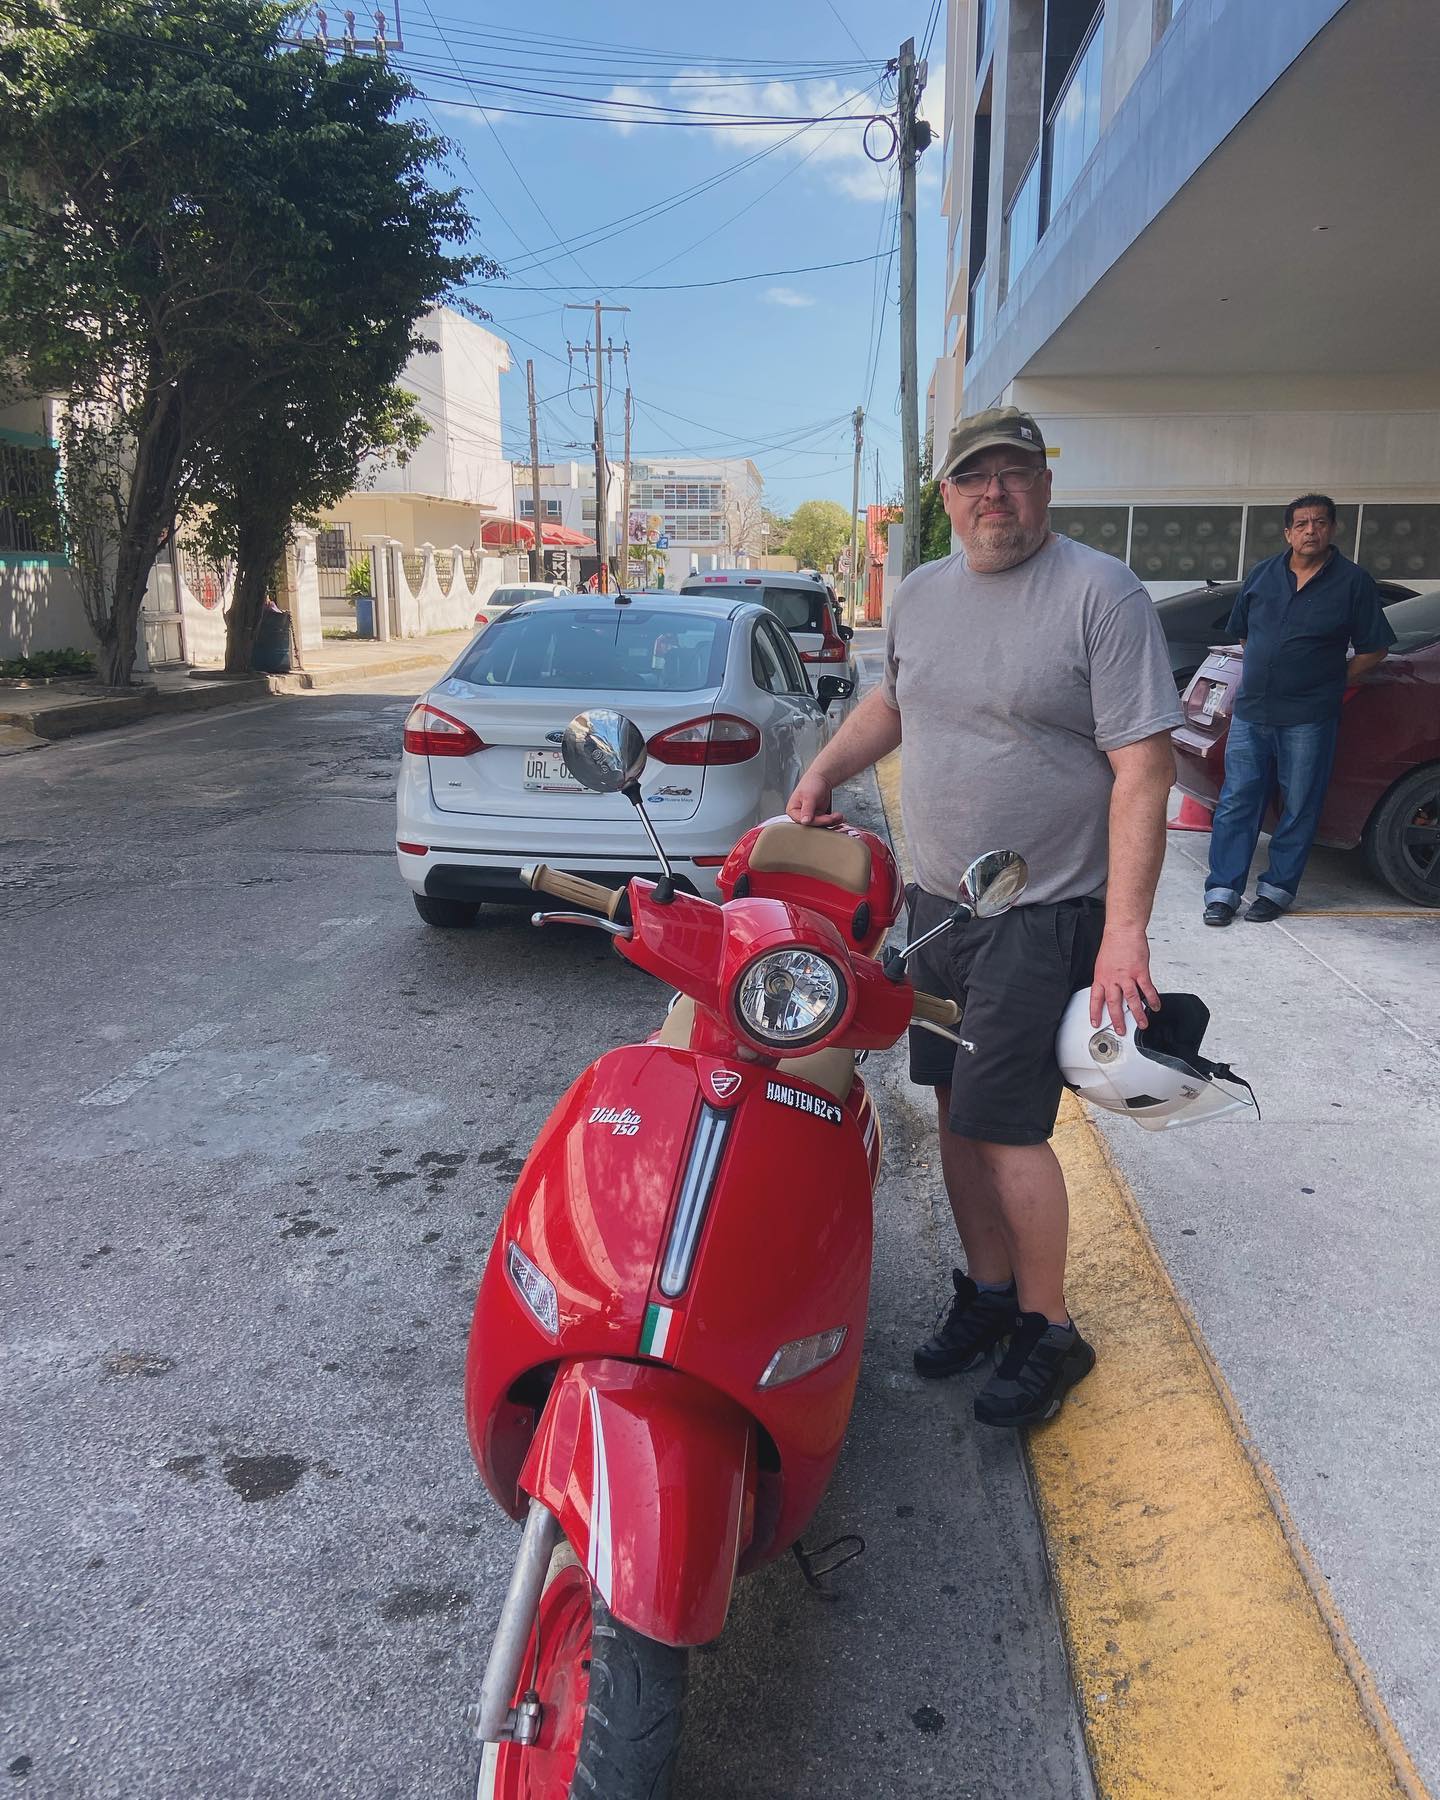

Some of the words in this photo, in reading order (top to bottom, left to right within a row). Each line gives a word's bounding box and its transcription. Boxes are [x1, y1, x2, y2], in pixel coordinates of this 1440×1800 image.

[527, 761, 574, 779] URL-0
[766, 1082, 794, 1106] HANG
[795, 1091, 813, 1113] TEN
[814, 1098, 827, 1118] 62
[588, 1107, 642, 1125] Vitalia
[611, 1124, 640, 1136] 150
